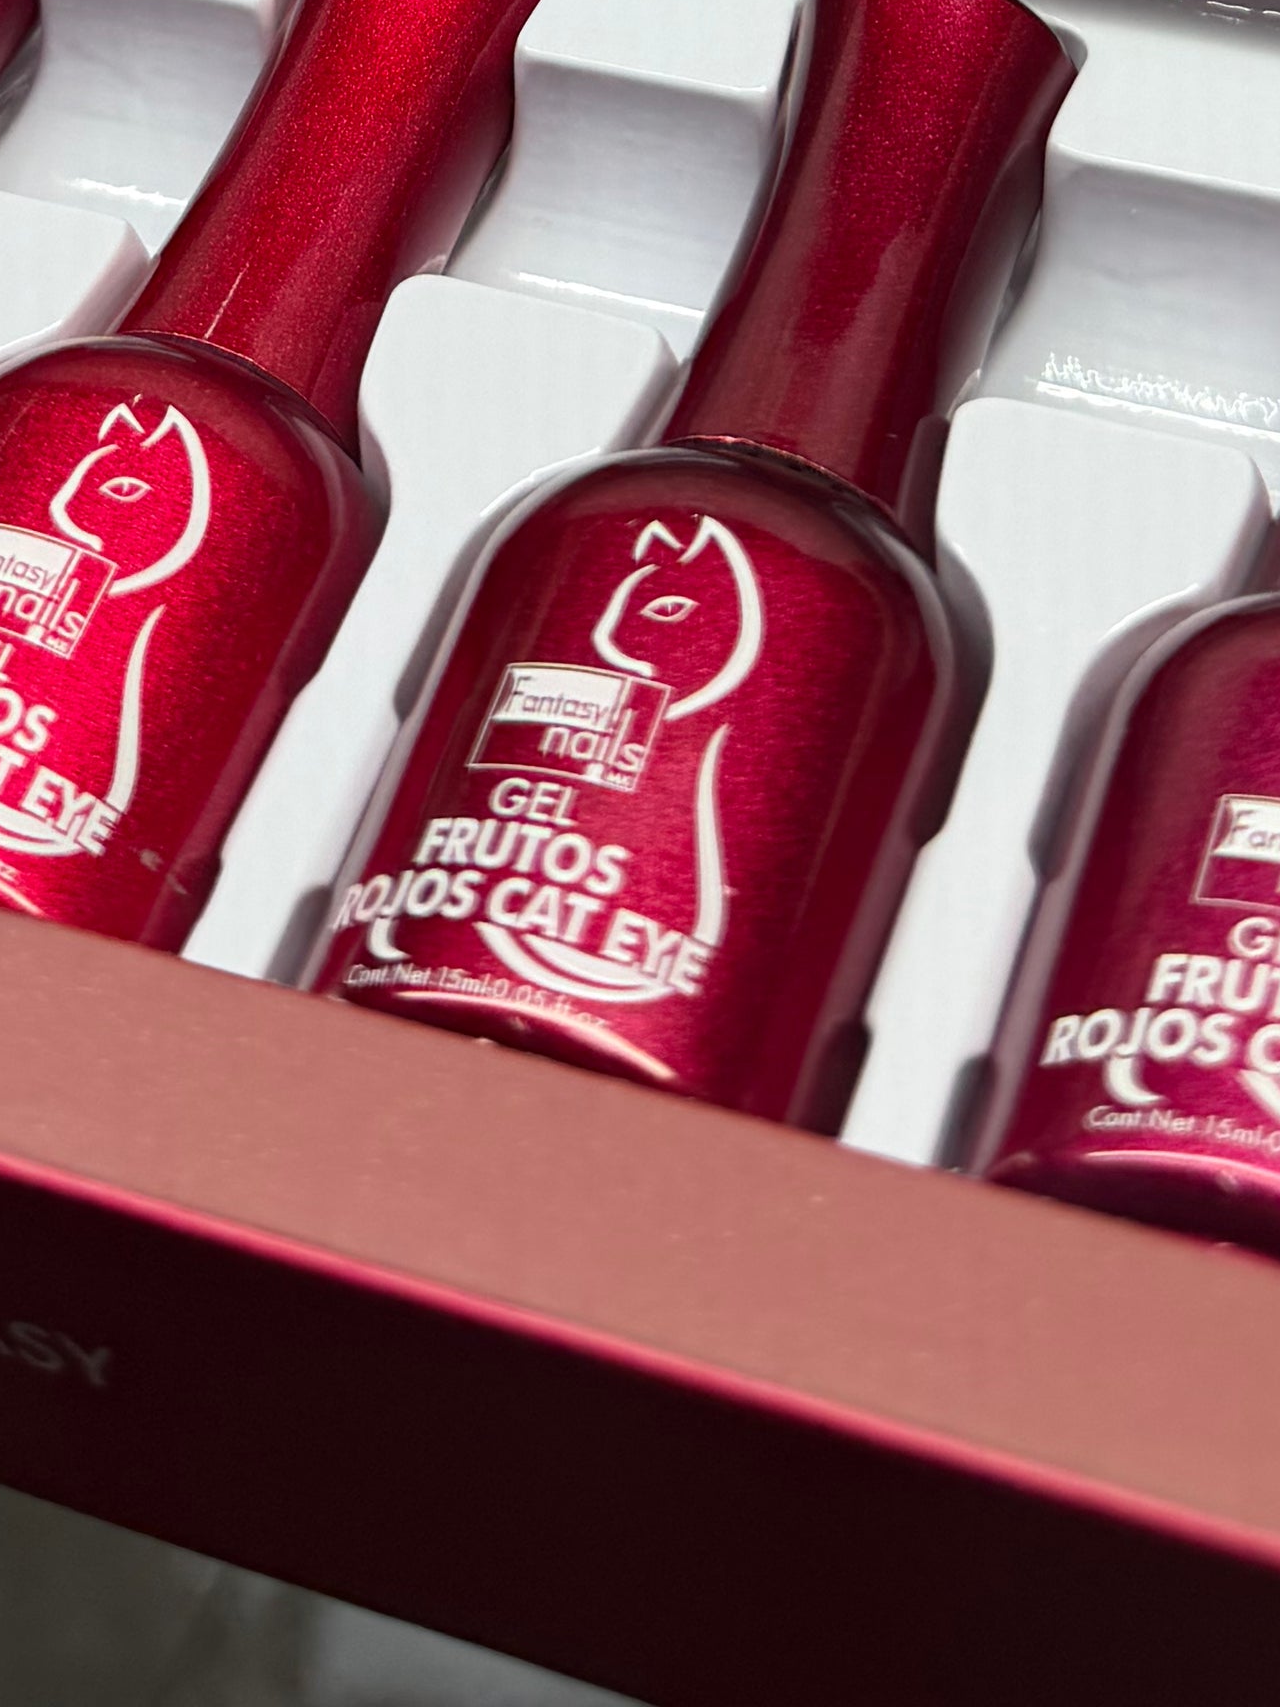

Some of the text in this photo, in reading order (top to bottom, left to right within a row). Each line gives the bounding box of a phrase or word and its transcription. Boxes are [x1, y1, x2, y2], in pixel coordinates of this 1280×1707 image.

[506, 676, 608, 723] Fantasy
[538, 709, 647, 772] nails
[21, 765, 121, 857] EYE
[488, 777, 580, 826] GEL
[414, 817, 629, 895] FRUTOS
[333, 868, 716, 996] ROJOS CAT EYE
[1039, 1007, 1236, 1067] ROJOS
